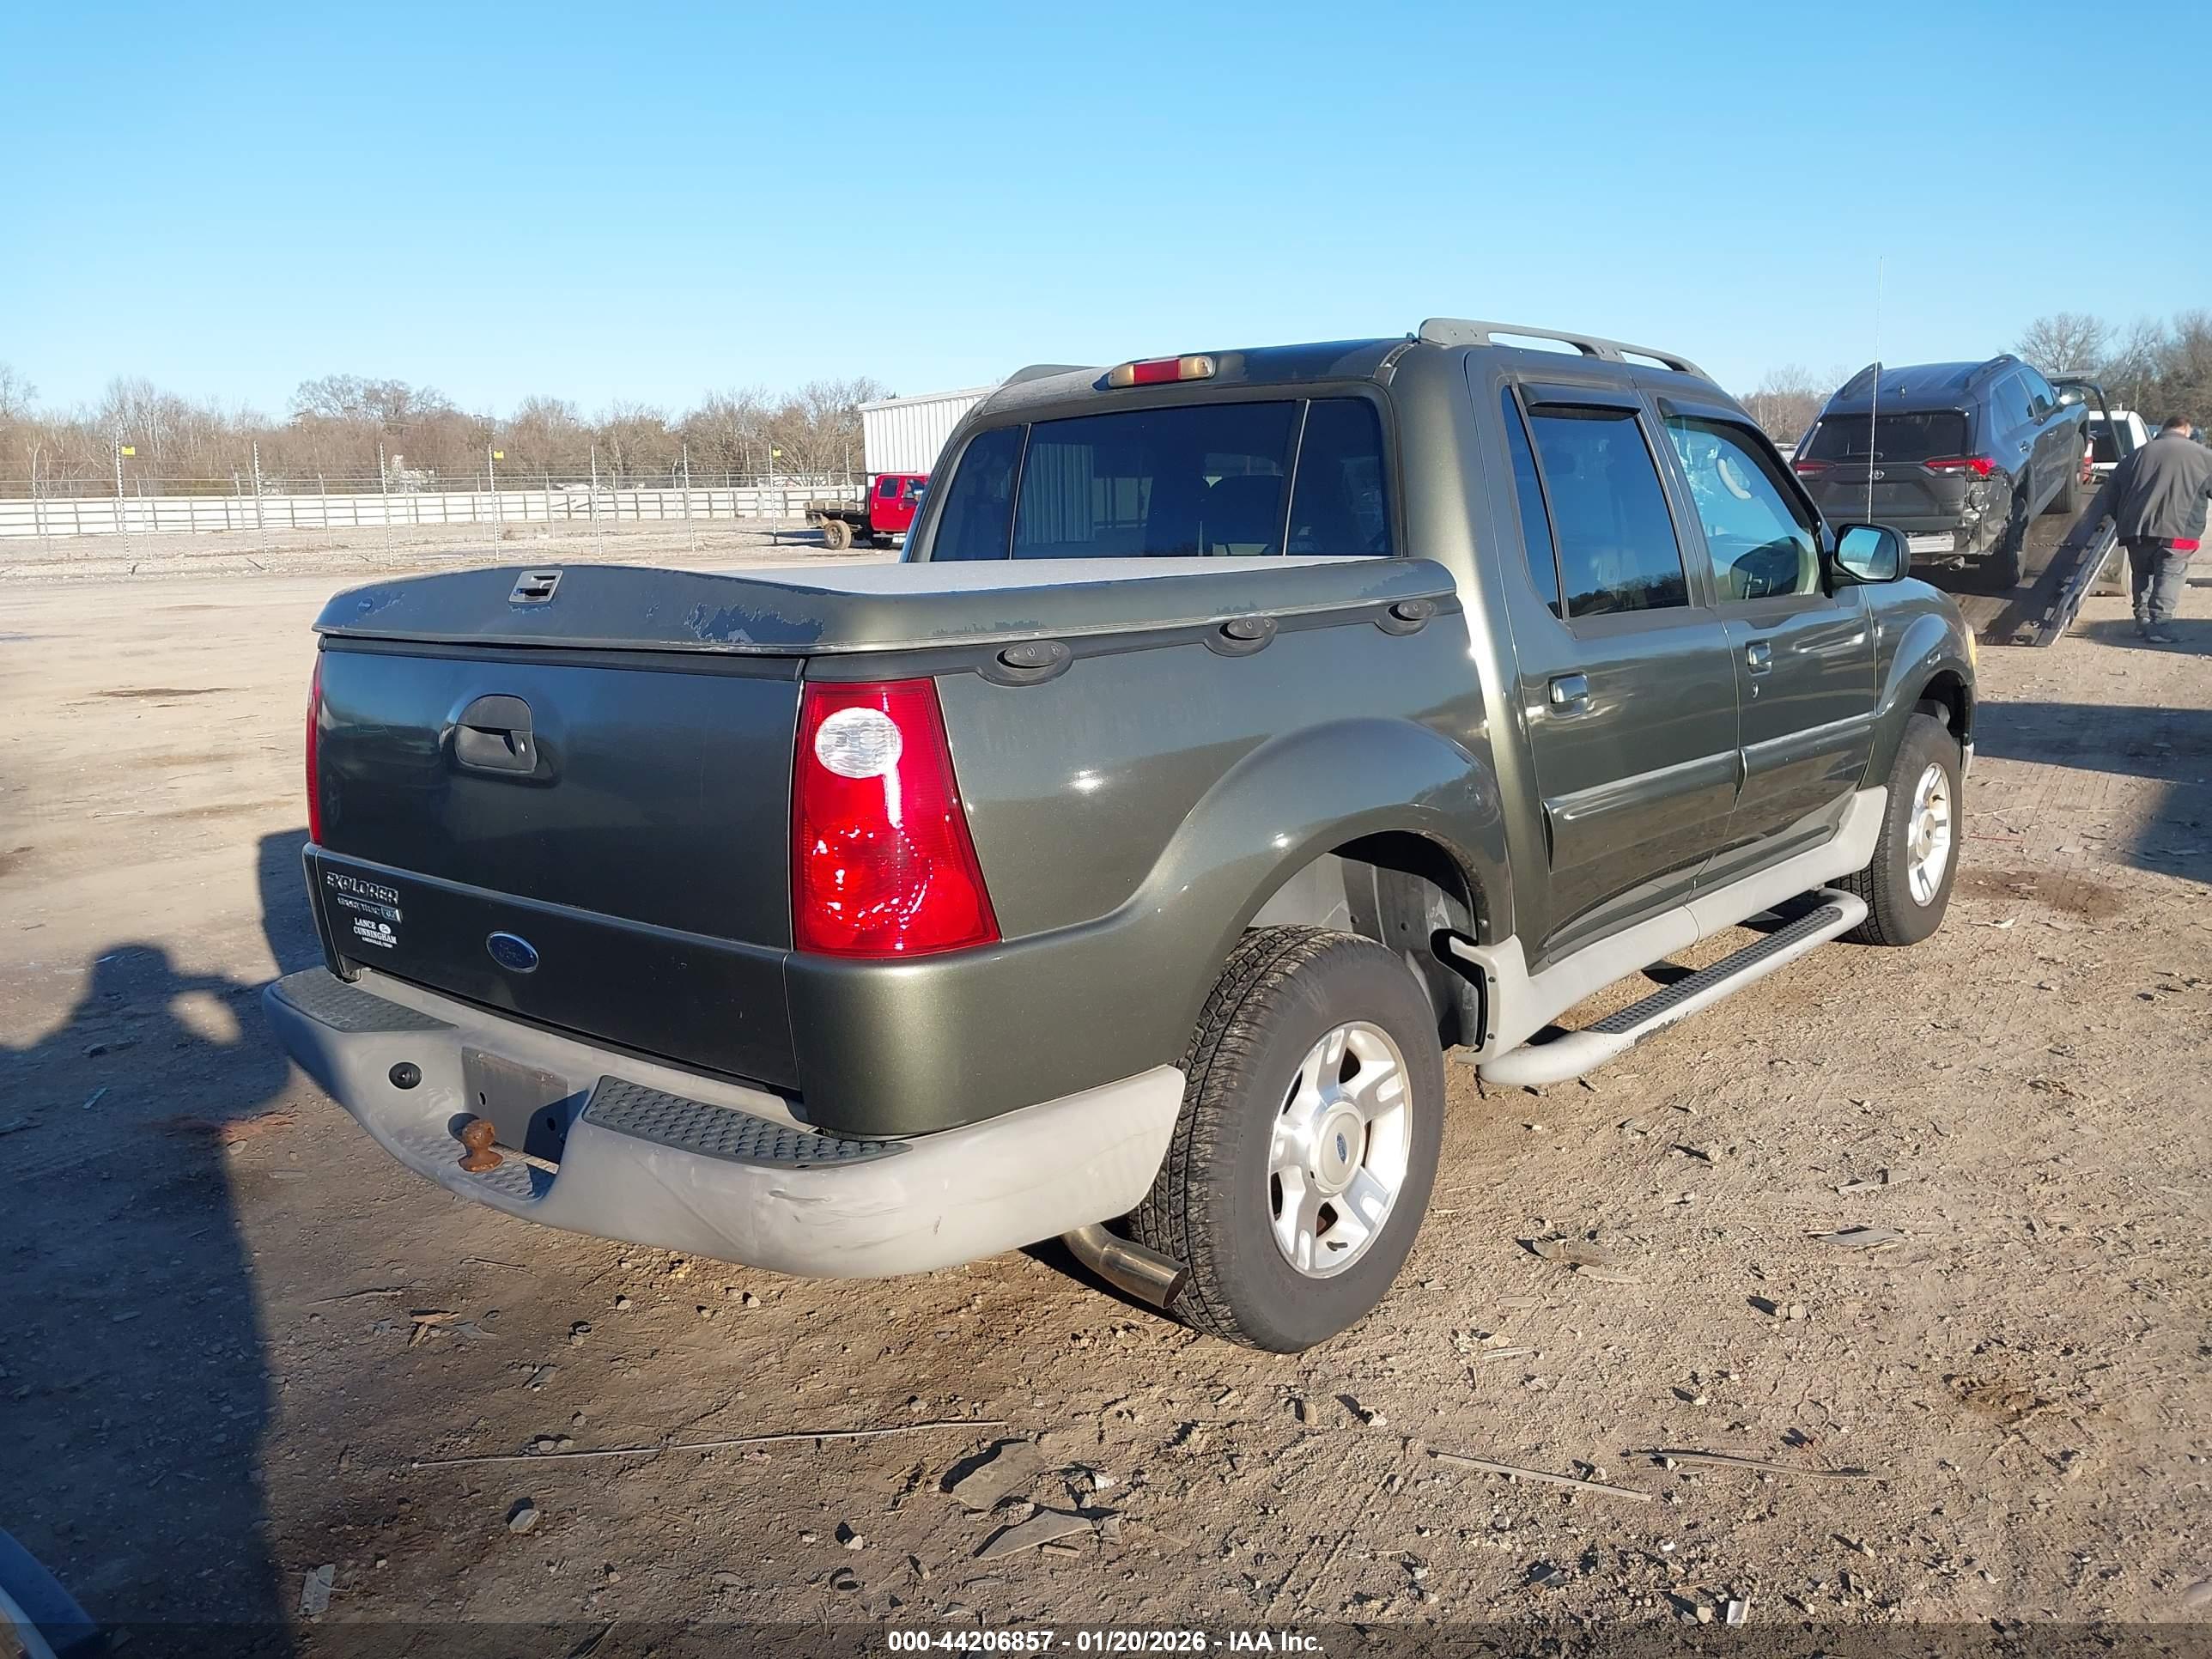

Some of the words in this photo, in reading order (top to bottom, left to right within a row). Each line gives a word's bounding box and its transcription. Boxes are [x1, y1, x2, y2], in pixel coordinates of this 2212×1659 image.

[326, 871, 398, 904] EXPLORER
[354, 917, 377, 930] LANCE
[353, 926, 398, 945] CUNNINGHAM
